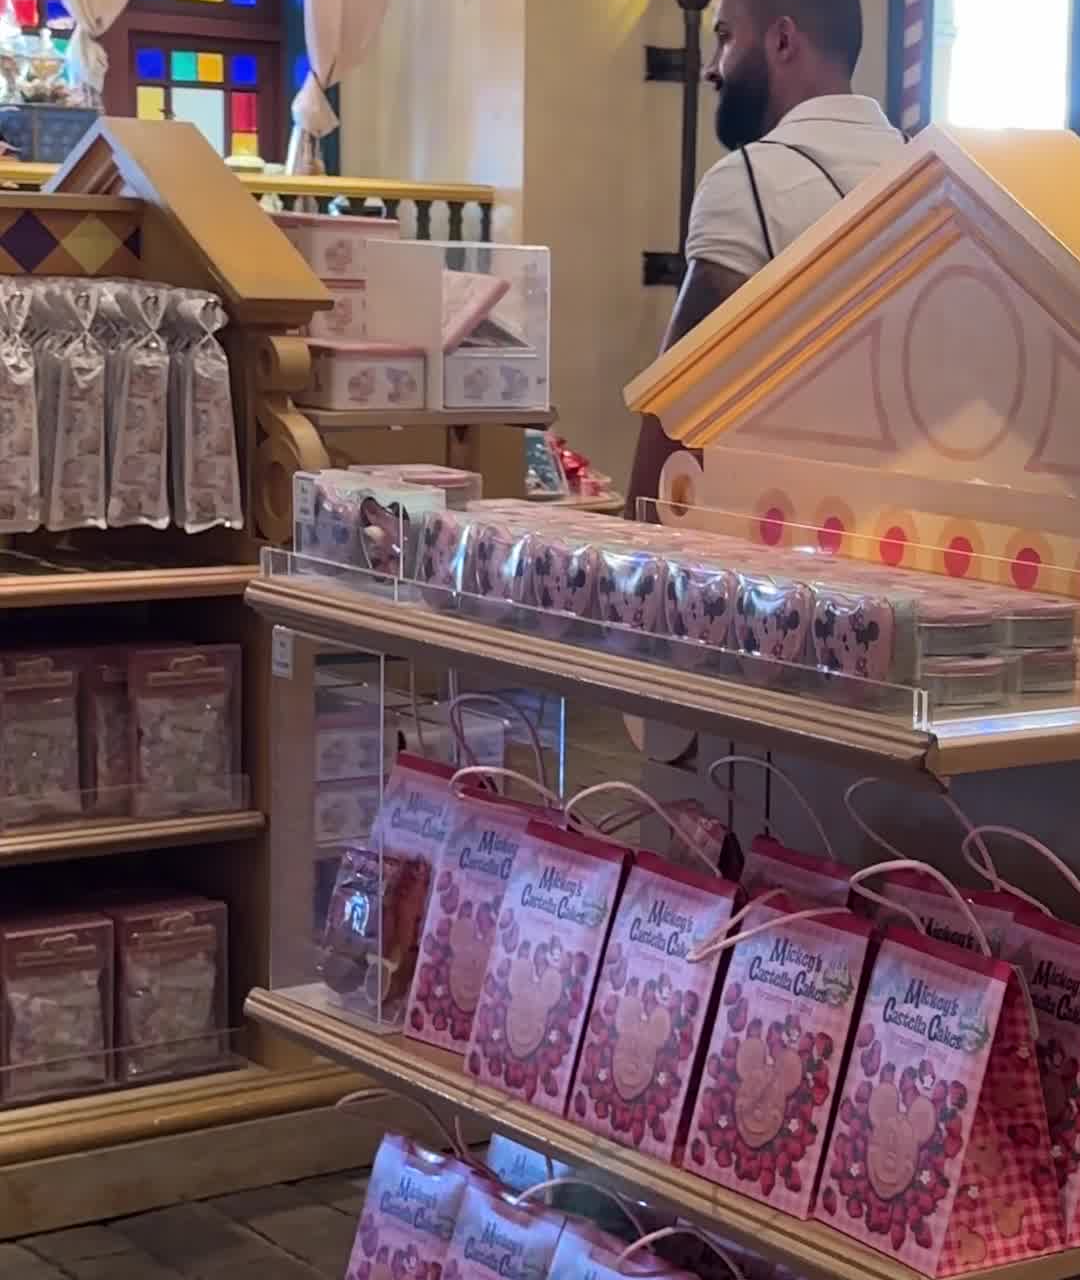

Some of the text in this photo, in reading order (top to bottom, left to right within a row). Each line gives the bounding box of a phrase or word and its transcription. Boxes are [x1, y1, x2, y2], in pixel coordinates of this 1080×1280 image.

[647, 900, 694, 934] Mickey's
[749, 955, 794, 995] Castella
[769, 936, 823, 974] Mickey's
[903, 977, 960, 1018] Mickey's
[882, 995, 927, 1035] Castella
[926, 1013, 964, 1051] Cakes
